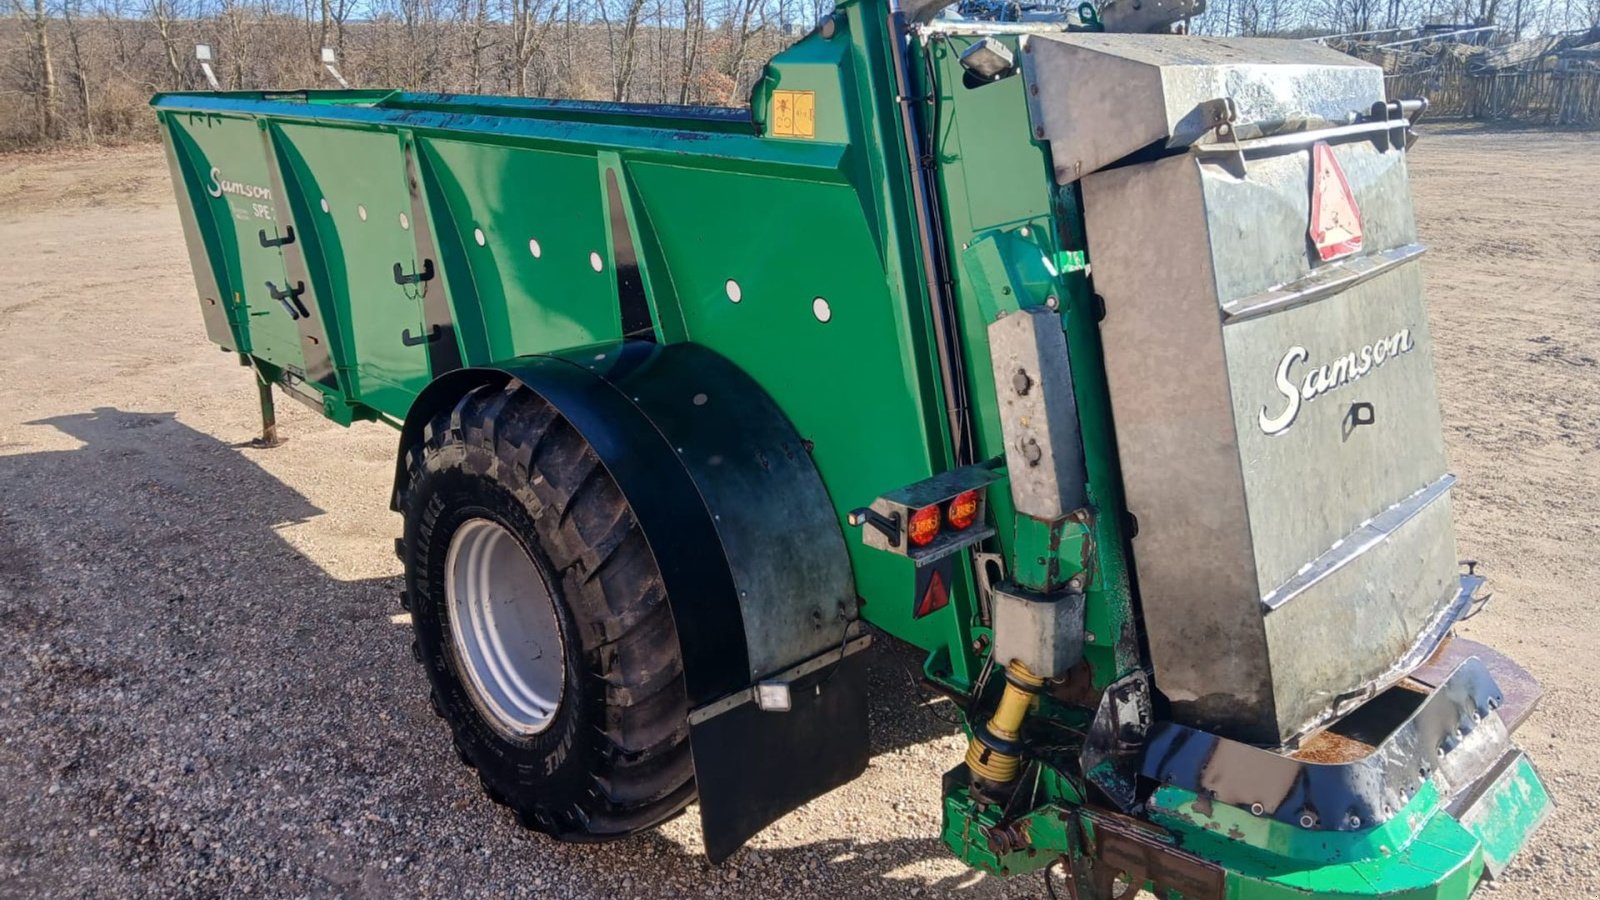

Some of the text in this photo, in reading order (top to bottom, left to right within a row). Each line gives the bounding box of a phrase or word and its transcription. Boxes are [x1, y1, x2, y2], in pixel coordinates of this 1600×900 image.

[207, 167, 272, 199] Samson
[251, 203, 271, 220] SPE
[1258, 328, 1414, 436] Samson
